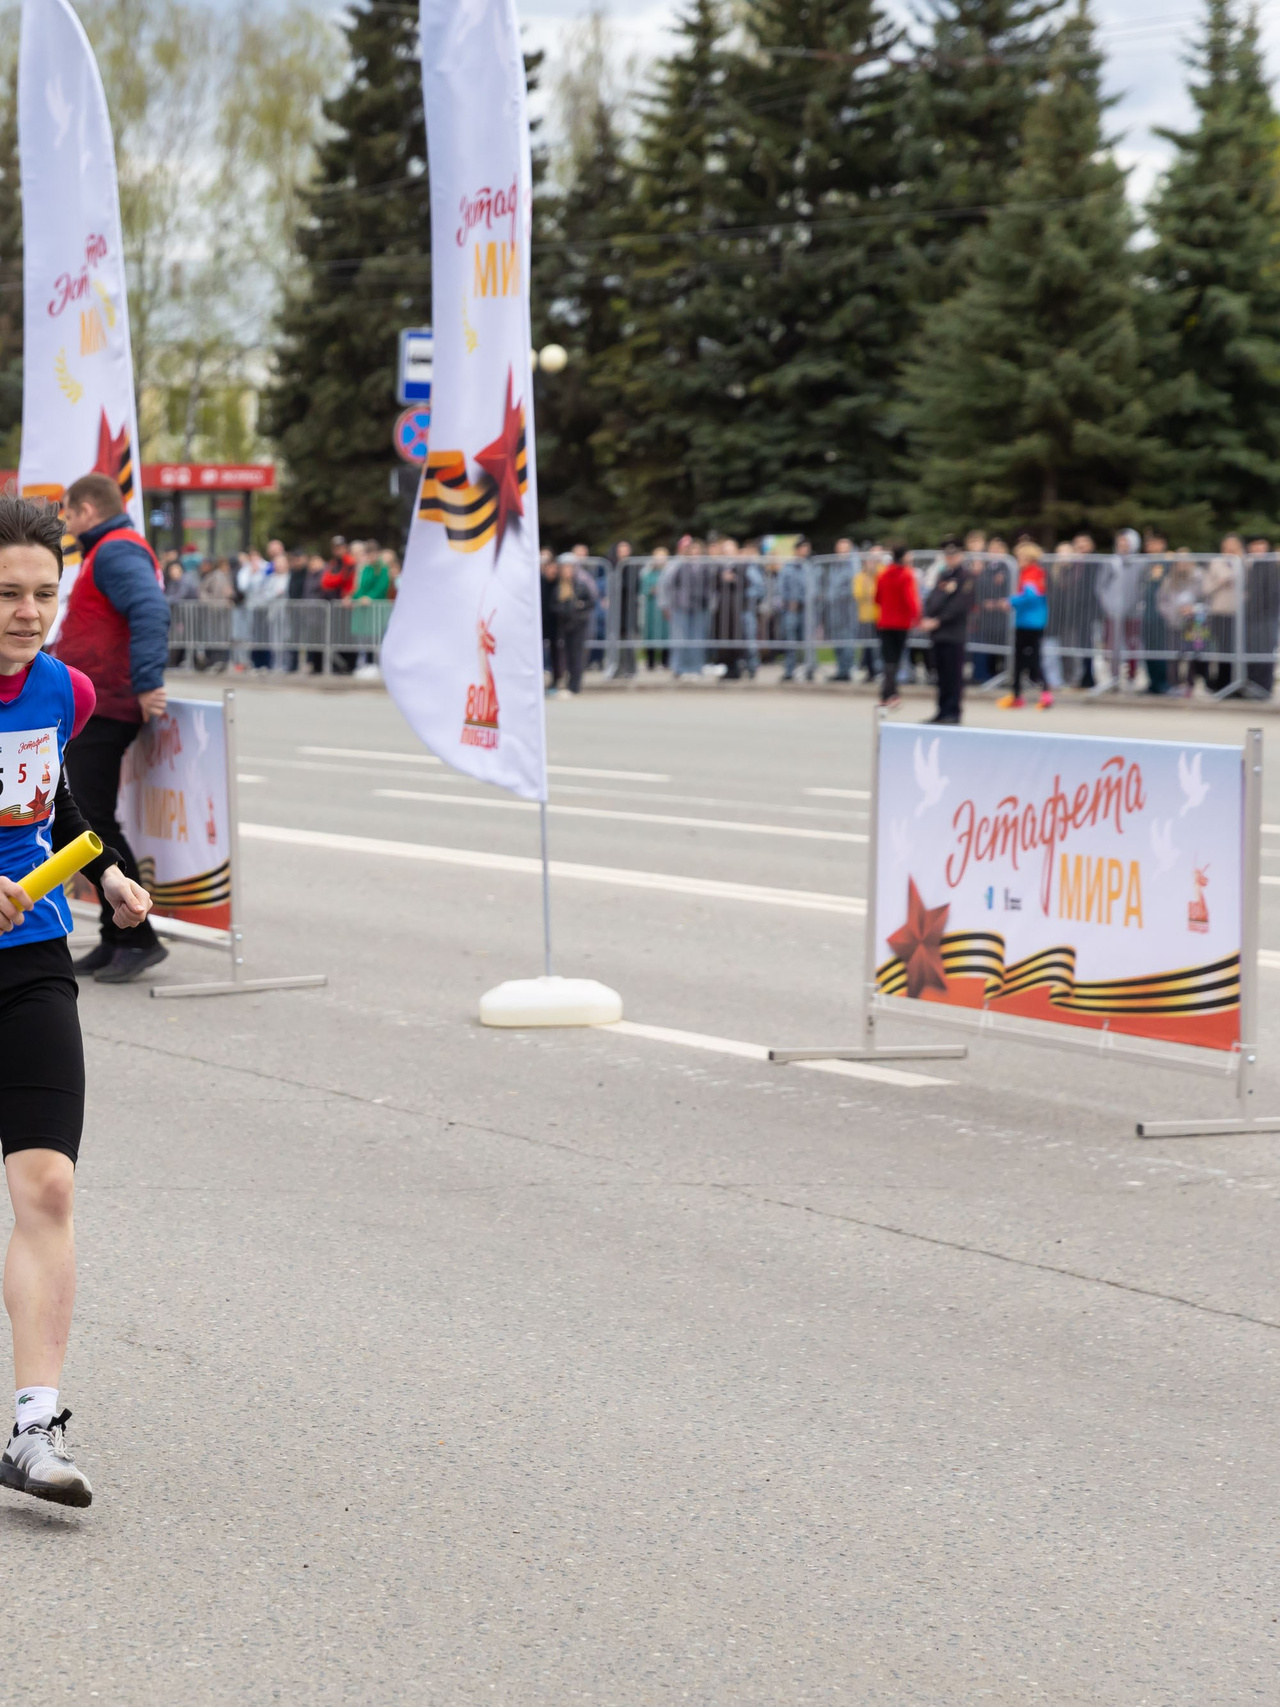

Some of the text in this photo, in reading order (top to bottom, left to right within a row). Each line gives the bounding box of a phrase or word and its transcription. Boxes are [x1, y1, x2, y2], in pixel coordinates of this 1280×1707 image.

[18, 763, 27, 783] 5
[945, 755, 1147, 917] Эстафета
[1058, 853, 1144, 930] МИРА
